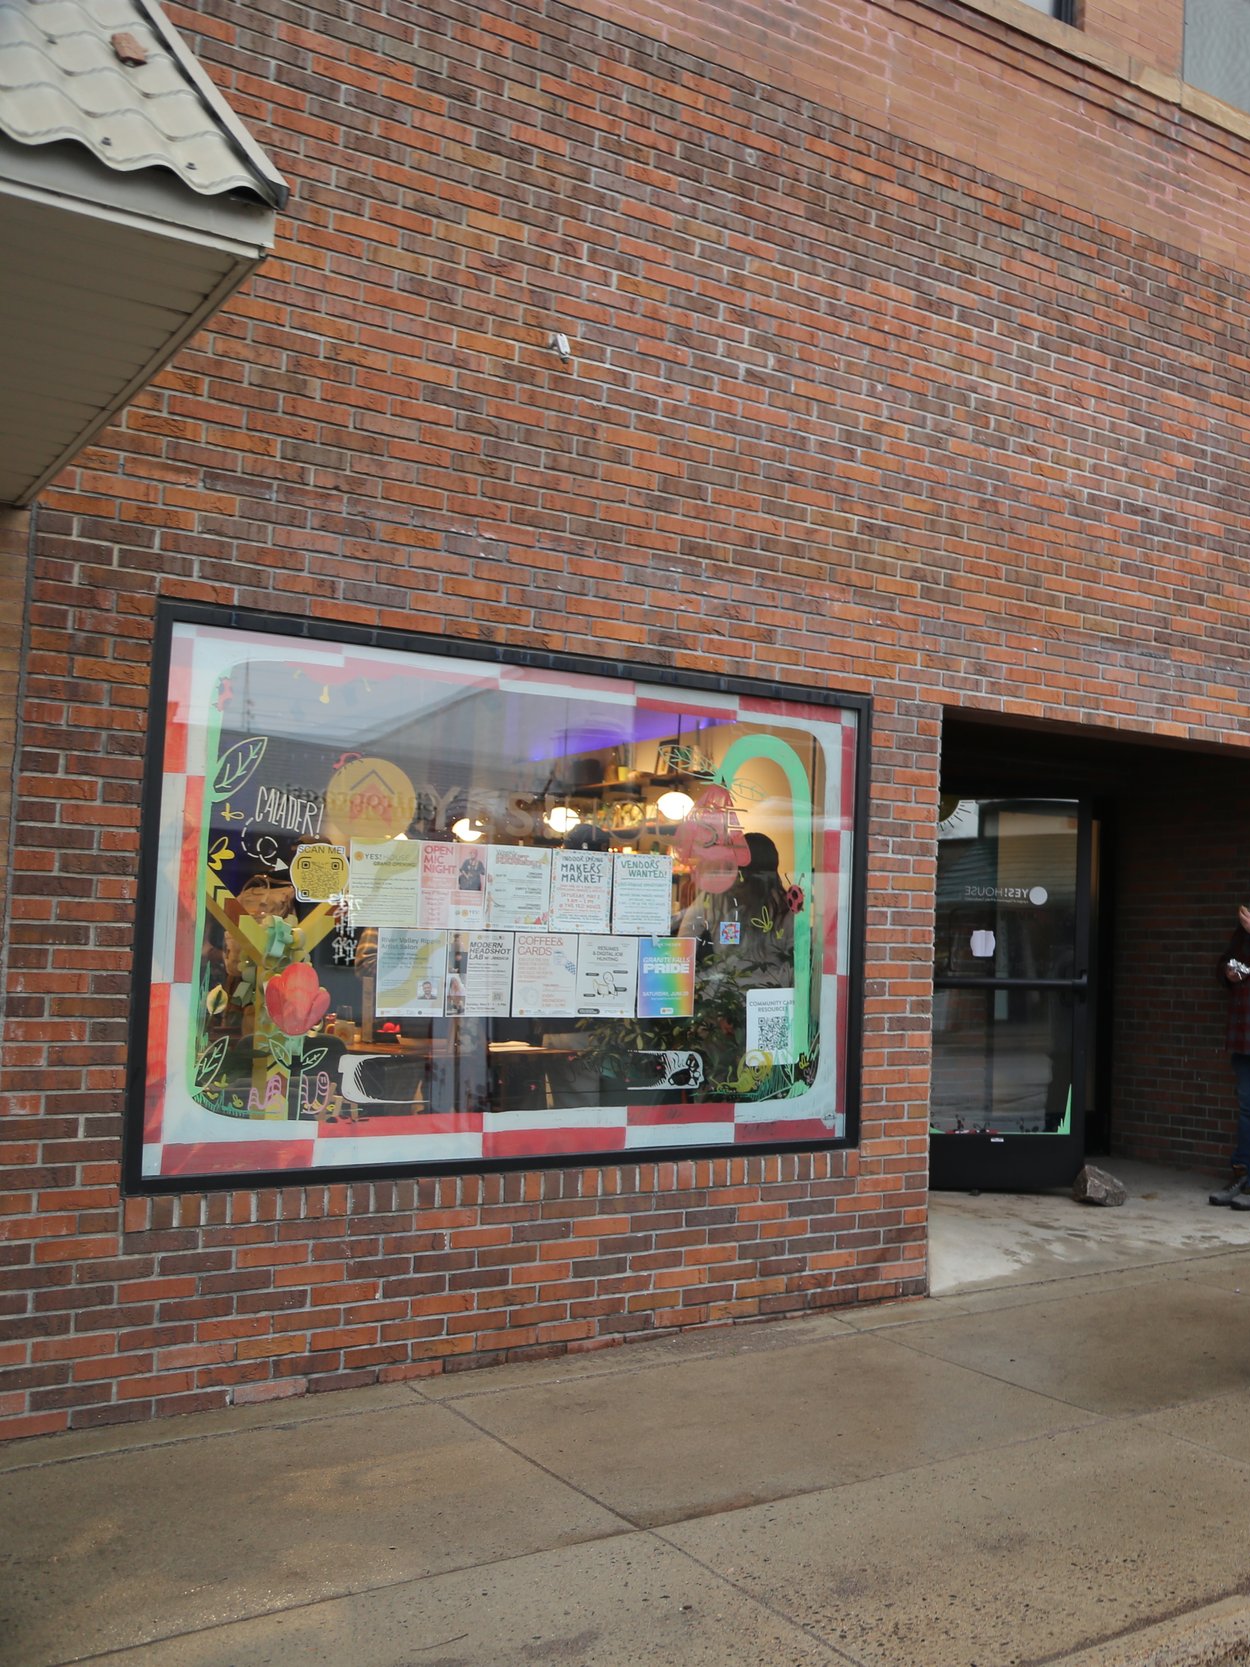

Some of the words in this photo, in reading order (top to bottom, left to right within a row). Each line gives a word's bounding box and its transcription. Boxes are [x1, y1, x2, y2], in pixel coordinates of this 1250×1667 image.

[255, 785, 325, 840] CALADER!
[298, 845, 325, 854] SCAN
[328, 846, 345, 855] ME!
[424, 845, 454, 855] OPEN
[424, 855, 445, 865] MIC
[621, 860, 660, 869] VENDORS
[423, 865, 457, 875] NIGHT
[561, 863, 602, 874] MAKERS
[561, 873, 604, 884] MARKET
[628, 869, 668, 879] WANTED!
[470, 941, 504, 949] MODERN
[517, 946, 553, 956] CARDS
[642, 963, 690, 974] PRIDE
